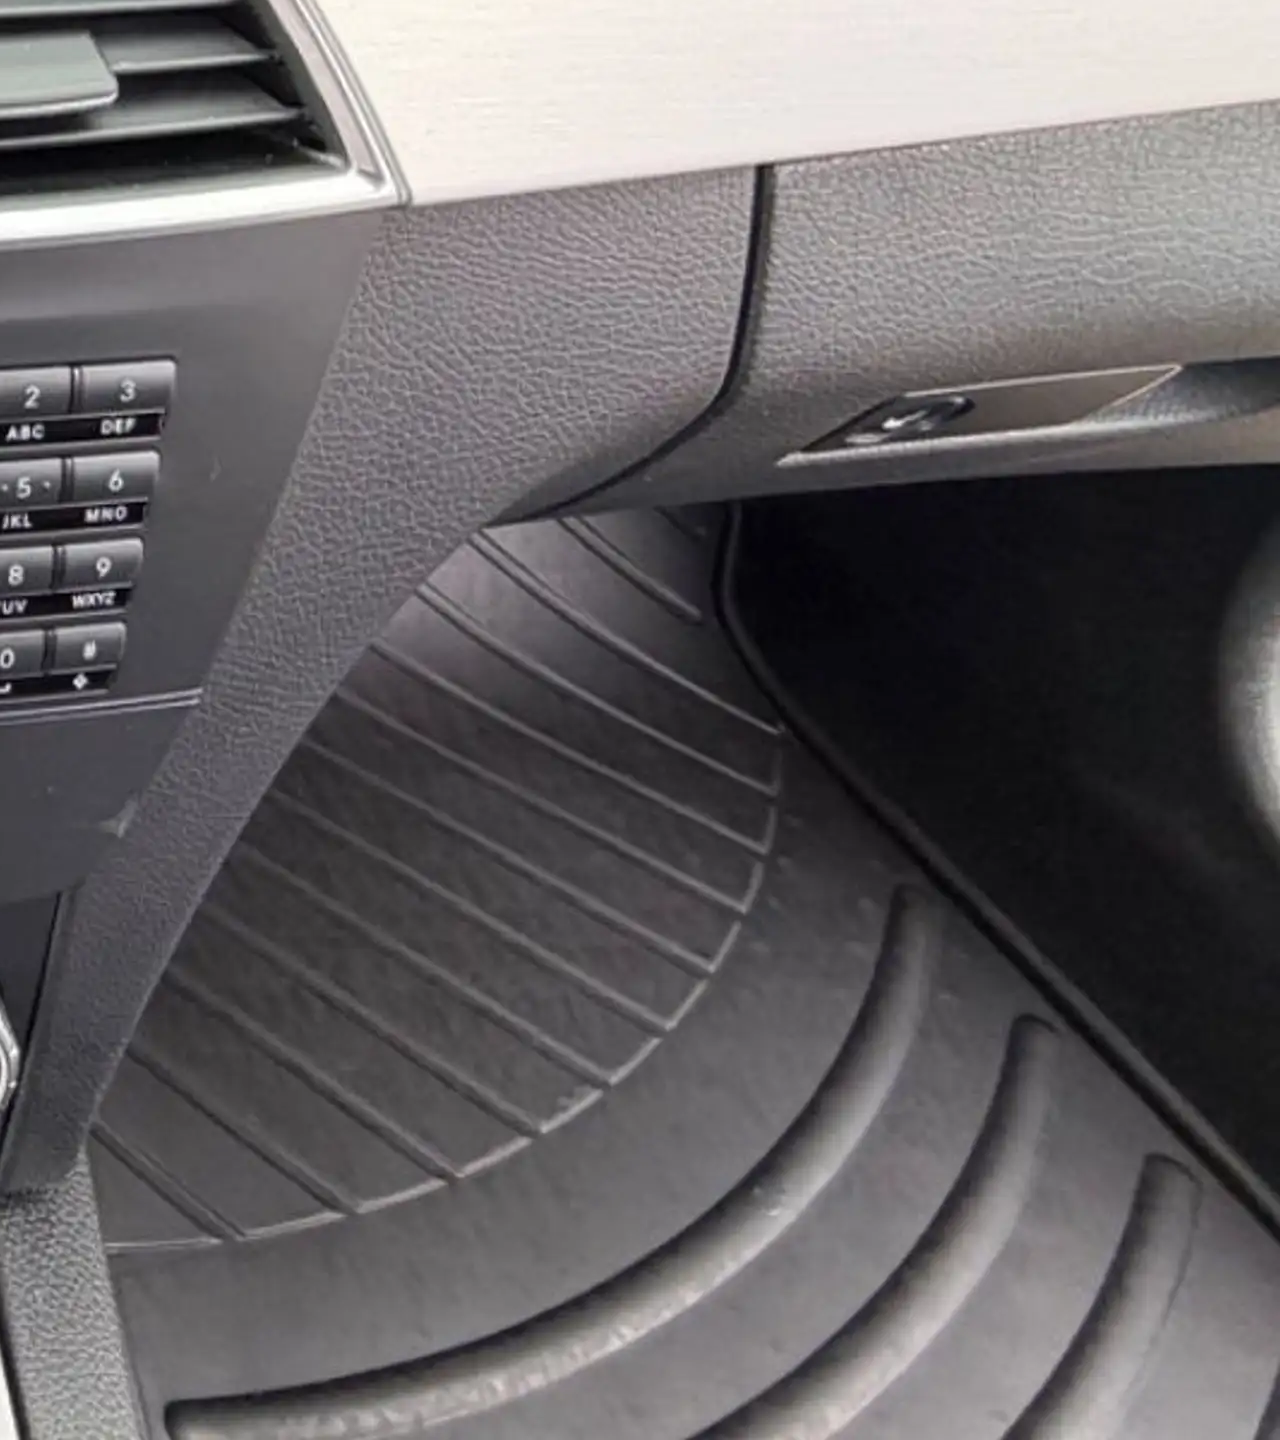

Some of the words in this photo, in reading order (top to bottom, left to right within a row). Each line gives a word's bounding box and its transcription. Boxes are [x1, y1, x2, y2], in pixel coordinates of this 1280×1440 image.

[25, 386, 40, 408] 2
[120, 381, 135, 402] 3
[6, 424, 44, 441] ABC
[101, 418, 136, 436] DEF
[16, 479, 31, 498] 5
[109, 470, 122, 491] 6
[2, 513, 32, 529] JKL
[85, 507, 127, 523] MNO
[8, 566, 23, 586] 8
[96, 557, 111, 578] 9
[72, 591, 116, 608] WXYZ
[0, 649, 14, 669] 0
